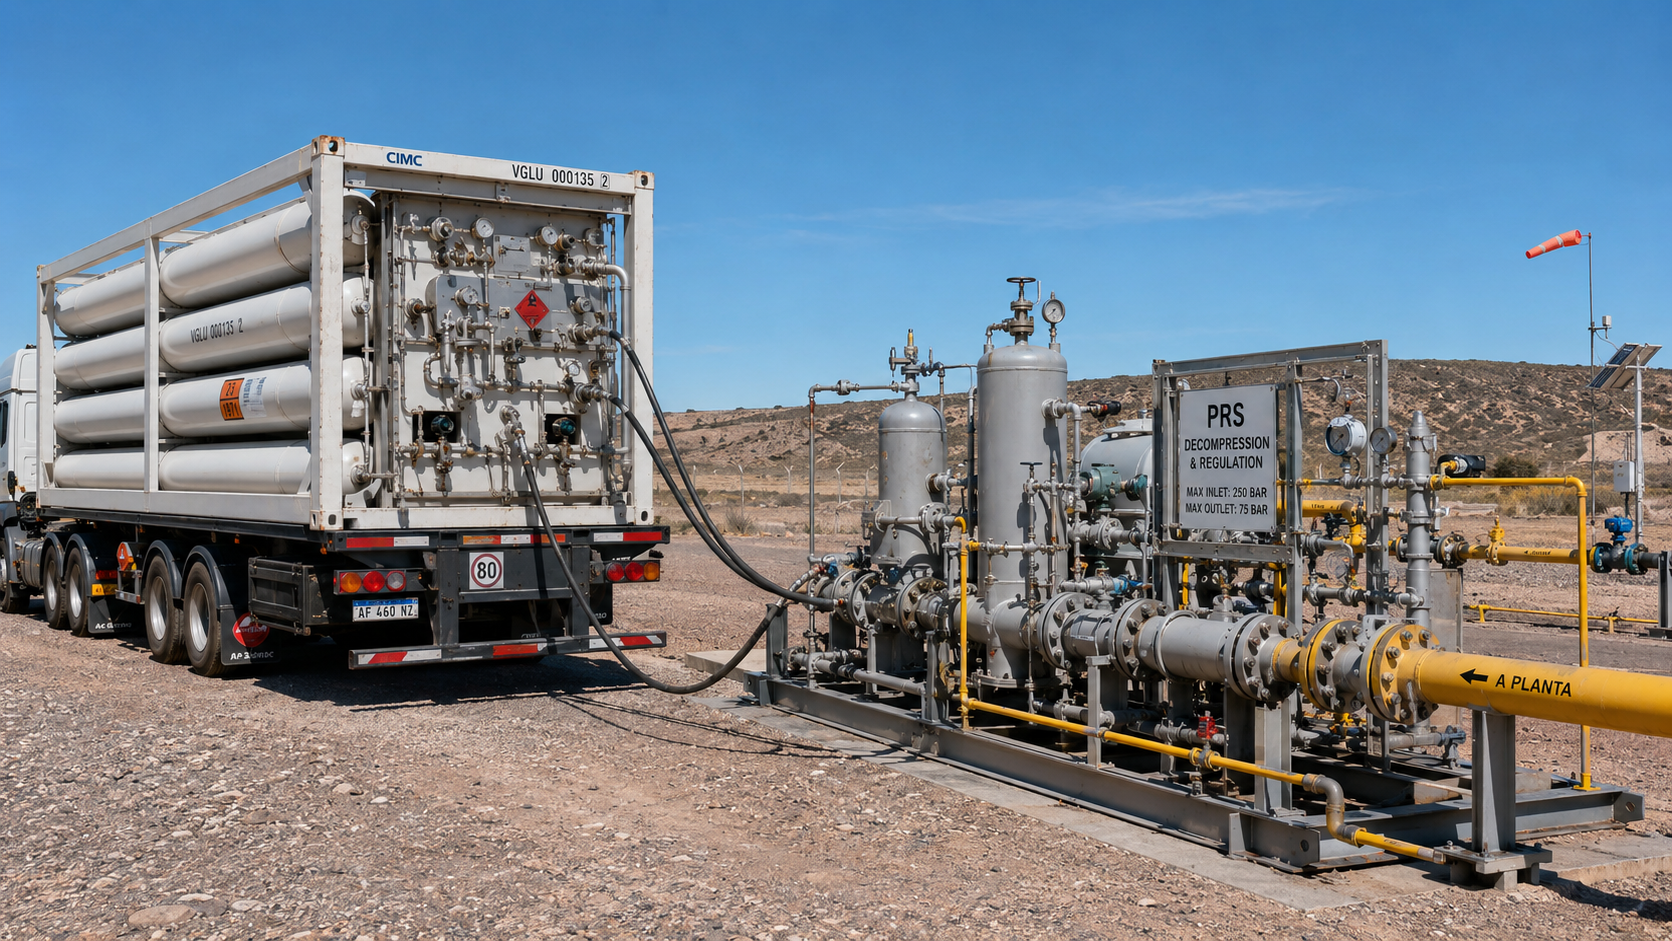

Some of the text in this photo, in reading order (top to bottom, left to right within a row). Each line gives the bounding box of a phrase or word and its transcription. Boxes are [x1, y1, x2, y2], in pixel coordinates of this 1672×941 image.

[386, 152, 423, 167] CIMC
[512, 164, 609, 188] VGLU 000135 2
[190, 317, 244, 343] VGLU 000135 2
[1207, 402, 1245, 428] PRS
[1184, 436, 1270, 451] DECOMPRESSION
[1190, 456, 1263, 469] & REGULATION
[1186, 487, 1267, 498] MAX INLET: 250 BAR
[1185, 503, 1268, 515] MAX OUTLET: 75 BAR
[477, 561, 496, 579] 80
[358, 604, 413, 618] AF 460 NZ
[1495, 674, 1572, 697] A PLANTA
